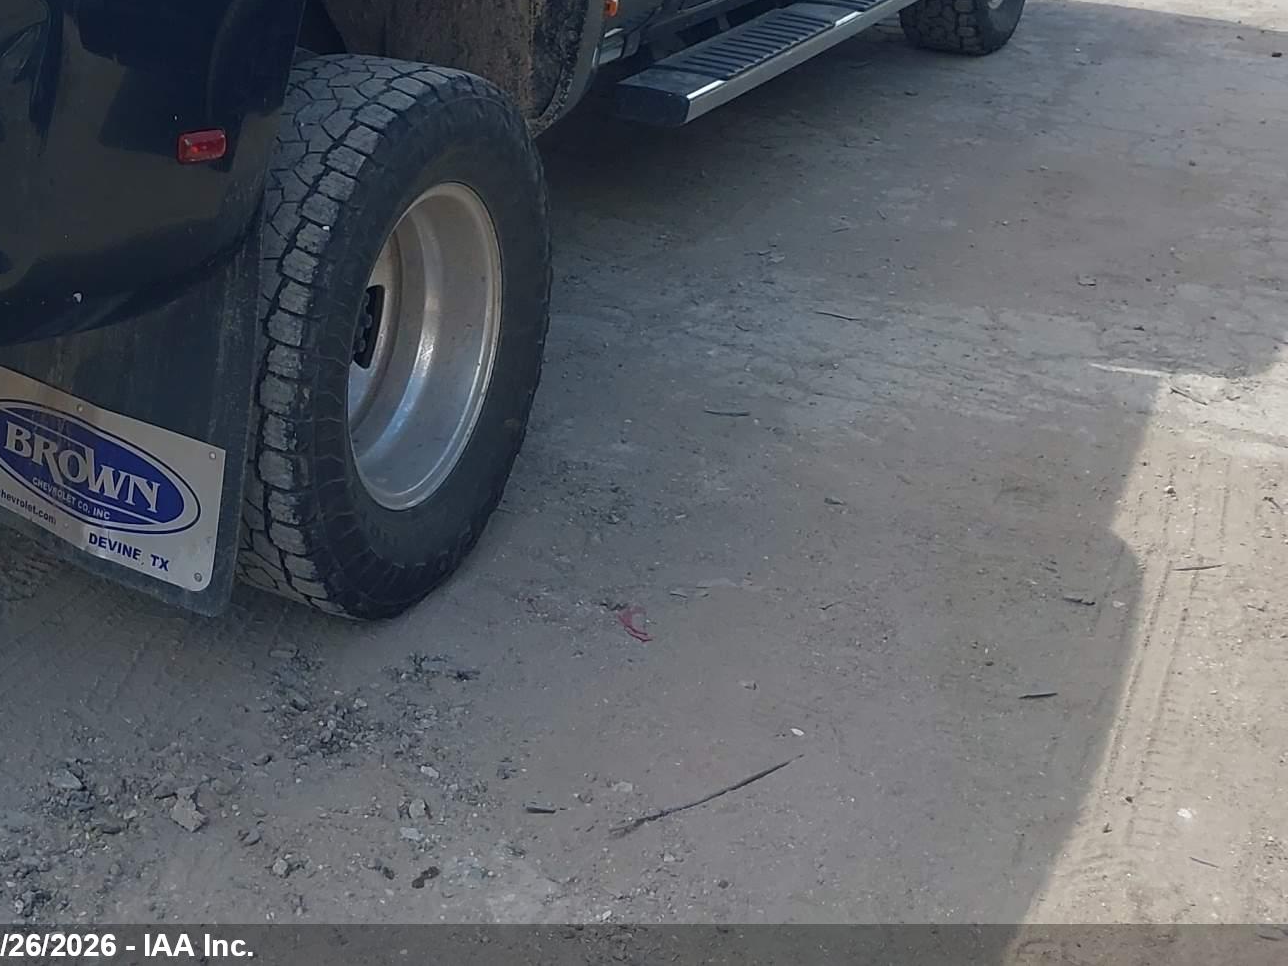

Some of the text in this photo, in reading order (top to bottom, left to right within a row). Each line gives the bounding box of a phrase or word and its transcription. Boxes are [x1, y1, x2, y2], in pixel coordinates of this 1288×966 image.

[3, 420, 161, 514] BROWN
[32, 476, 77, 507] CHEVROLET
[92, 506, 111, 520] INC
[150, 553, 170, 572] TX
